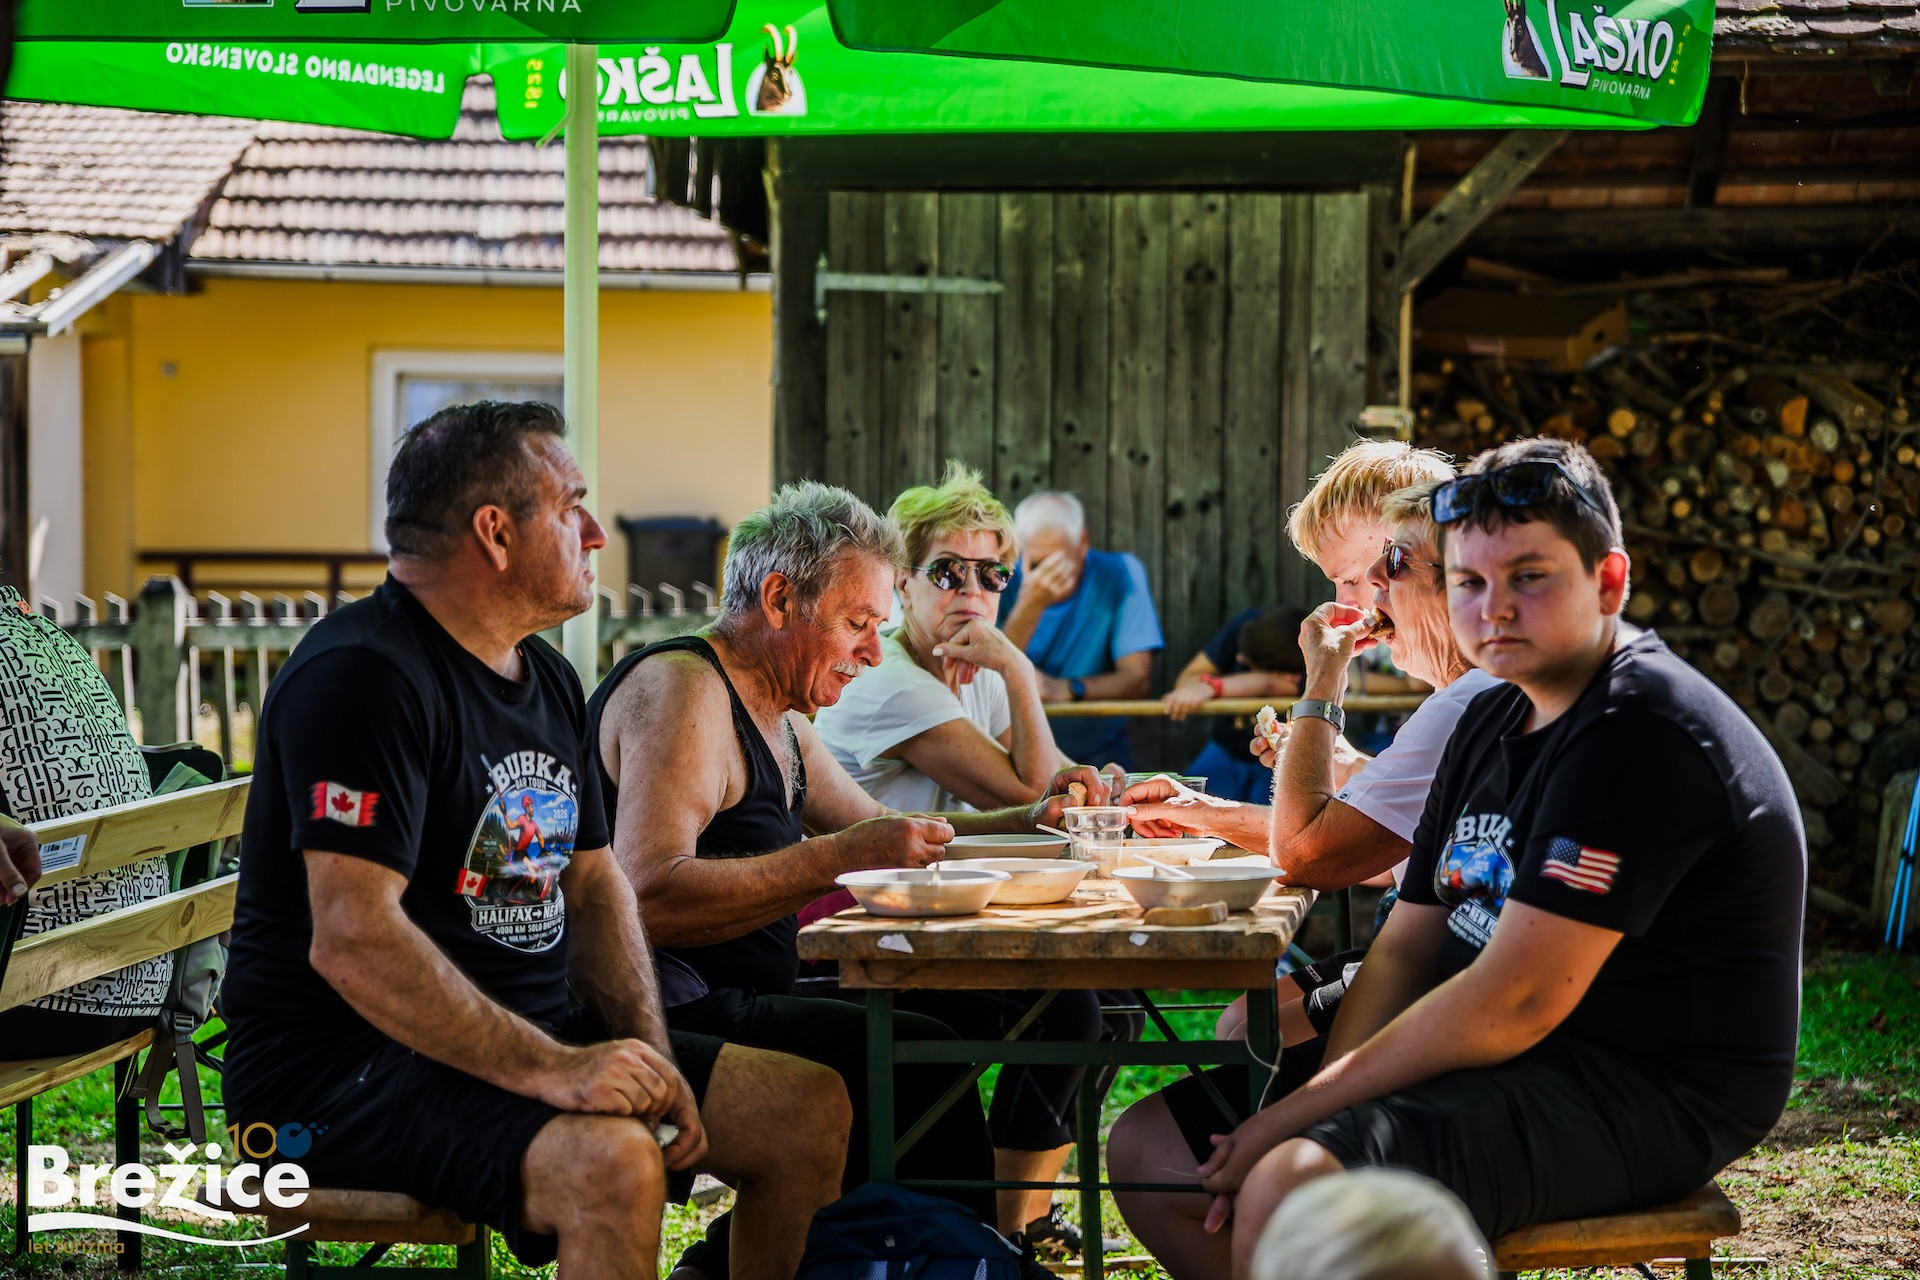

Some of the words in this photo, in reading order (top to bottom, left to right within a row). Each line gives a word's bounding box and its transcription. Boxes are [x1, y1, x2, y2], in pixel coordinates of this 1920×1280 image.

[385, 0, 582, 13] PIVOVARNA
[1547, 0, 1674, 89] LAŠKO
[1591, 78, 1650, 100] PIVOVARNA
[491, 750, 572, 796] BUBKA
[478, 907, 533, 926] HALIFAX
[495, 925, 514, 935] 4000
[514, 924, 526, 934] KM
[527, 922, 543, 932] SOLO
[1485, 917, 1499, 936] YO
